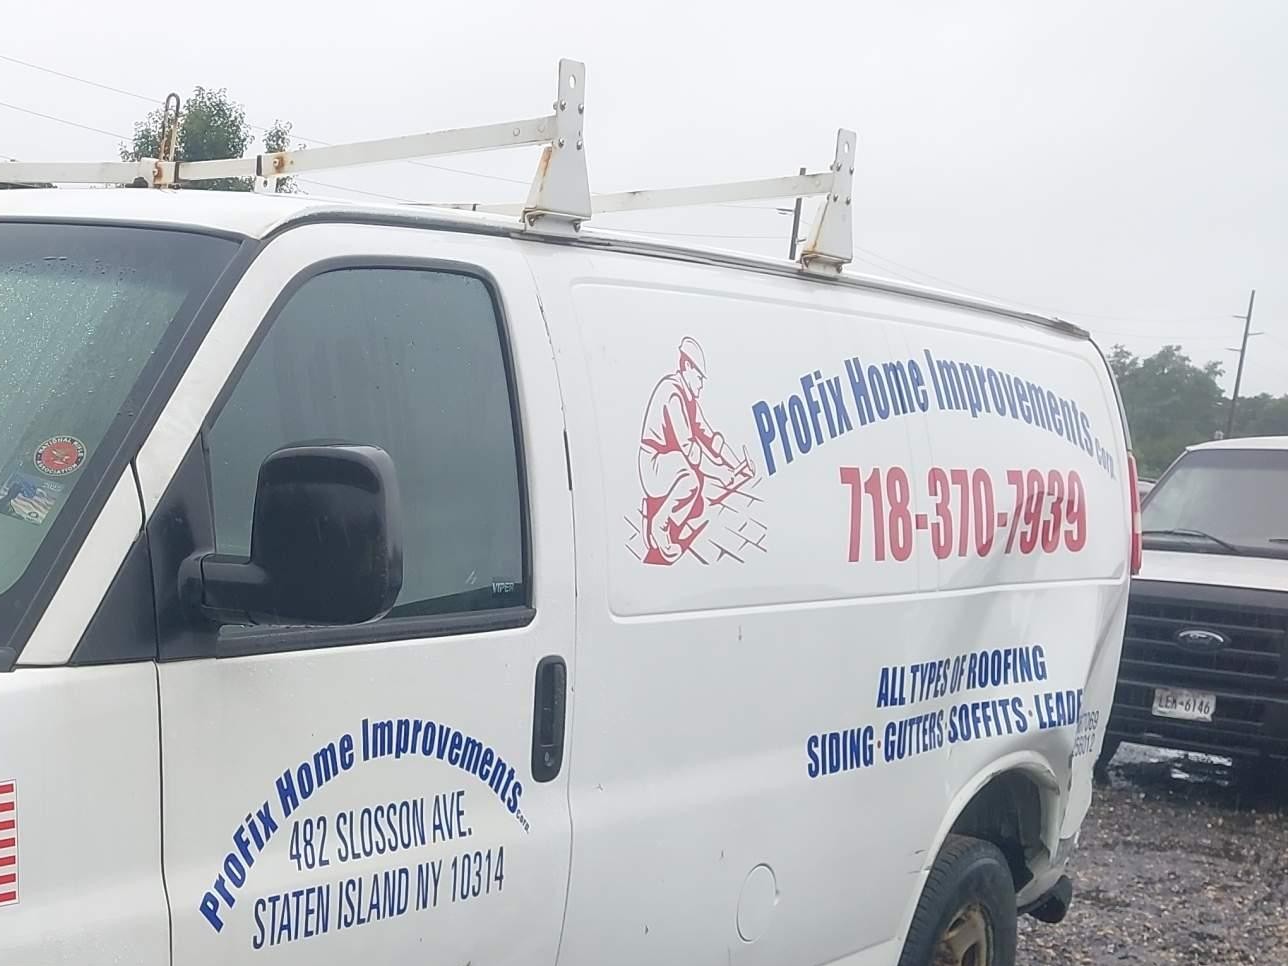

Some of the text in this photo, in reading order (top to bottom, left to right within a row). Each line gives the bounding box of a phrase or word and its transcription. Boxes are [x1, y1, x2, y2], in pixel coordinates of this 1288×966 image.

[38, 437, 72, 454] NATIONAL
[751, 370, 853, 477] ProFix
[847, 357, 929, 427] Home
[924, 349, 1095, 461] Improvements
[37, 460, 78, 474] ASSOCIATION
[839, 466, 1087, 563] 718-370-7939
[492, 582, 515, 593] VIPER
[876, 645, 1048, 708] ALL TYPES OF ROOFING
[806, 723, 874, 778] SIDING
[884, 714, 944, 763] GUTTERS
[948, 696, 1028, 742] SOFFITS
[199, 802, 279, 933] ProFix
[276, 733, 354, 818] Home
[361, 718, 523, 814] Improvements
[289, 791, 472, 871] 482 SLOSSON AVE.
[252, 846, 505, 950] STATEN ISLAND NY 10314
